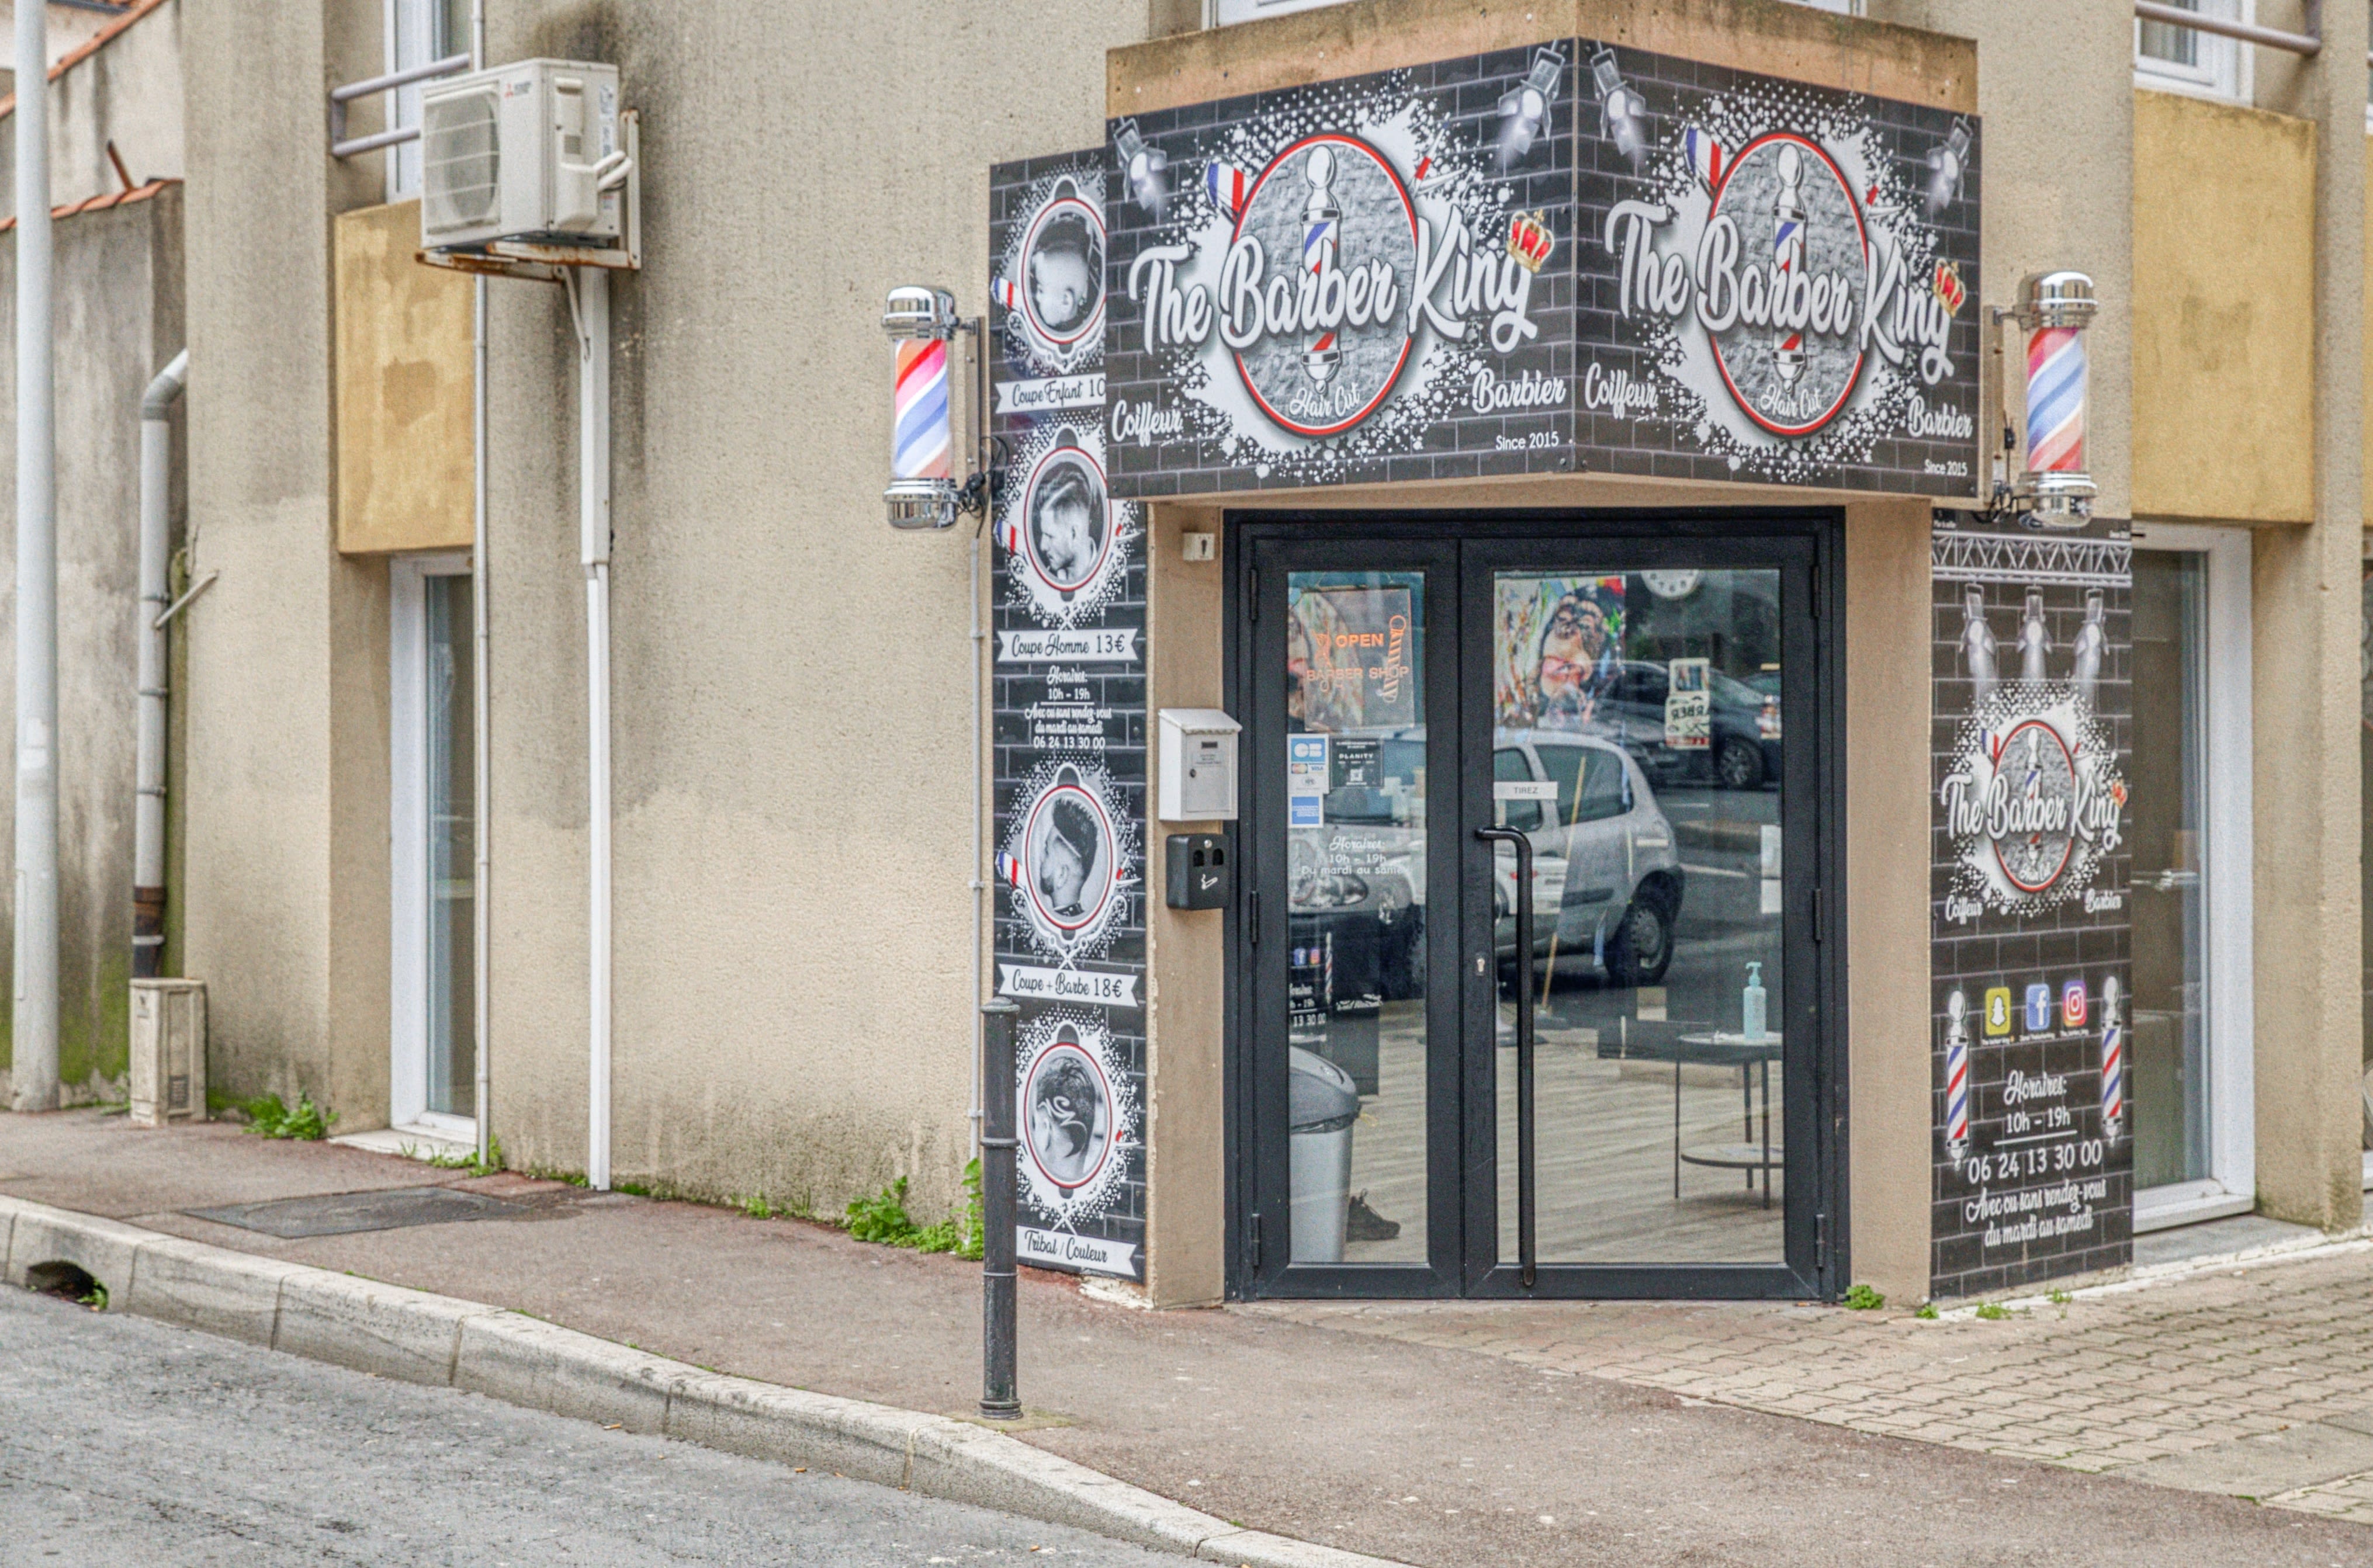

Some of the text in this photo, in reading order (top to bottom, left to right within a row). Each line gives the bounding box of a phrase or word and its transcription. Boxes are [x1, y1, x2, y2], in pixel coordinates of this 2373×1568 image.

[1130, 206, 1539, 354] The Barber King
[1605, 200, 1954, 384] The Barber King
[1013, 383, 1044, 407] Coupe
[1044, 380, 1083, 407] Enfant
[1290, 383, 1360, 419] Hair Cut
[1473, 368, 1566, 414] Barbier
[1585, 362, 1658, 418] Coiffeur
[1759, 383, 1823, 419] Hair Cut
[1111, 400, 1183, 446] Coiffeur
[1908, 396, 1972, 438] Barbier
[1495, 431, 1559, 451] Since 2015
[1924, 459, 1967, 476] Since 2015
[1012, 633, 1125, 657] Coupe Homme 13€
[1335, 633, 1384, 648] OPEN
[1047, 665, 1088, 685] Horaires:
[1307, 666, 1409, 681] BARBER SHOP
[1048, 688, 1064, 700] 10h
[1074, 688, 1090, 700] 19h
[1033, 736, 1106, 750] 06 24 13 30 00
[1514, 786, 1539, 795] TIREZ
[1941, 769, 2122, 851] The Barber King
[1321, 865, 1352, 875] mardi
[1356, 866, 1370, 875] au
[1329, 854, 1350, 864] 10h
[1366, 853, 1387, 864] 19h
[1945, 894, 1983, 925] Coiffeur
[2084, 889, 2122, 913] Barbier
[1013, 968, 1044, 994] Coupe
[1055, 972, 1090, 995] Barbe
[1094, 977, 1123, 998] 18€
[2004, 1069, 2068, 1105] Horaires:
[2006, 1111, 2031, 1133] 10h
[2048, 1105, 2071, 1128] 19h
[1968, 1138, 2102, 1184] 06 24 13 30 00
[1966, 1178, 2107, 1223] Avec ou sans rendez-vous
[1984, 1204, 2094, 1247] du mardi au samedi
[1024, 1229, 1057, 1254] Tribal
[1066, 1237, 1108, 1262] Couleur
